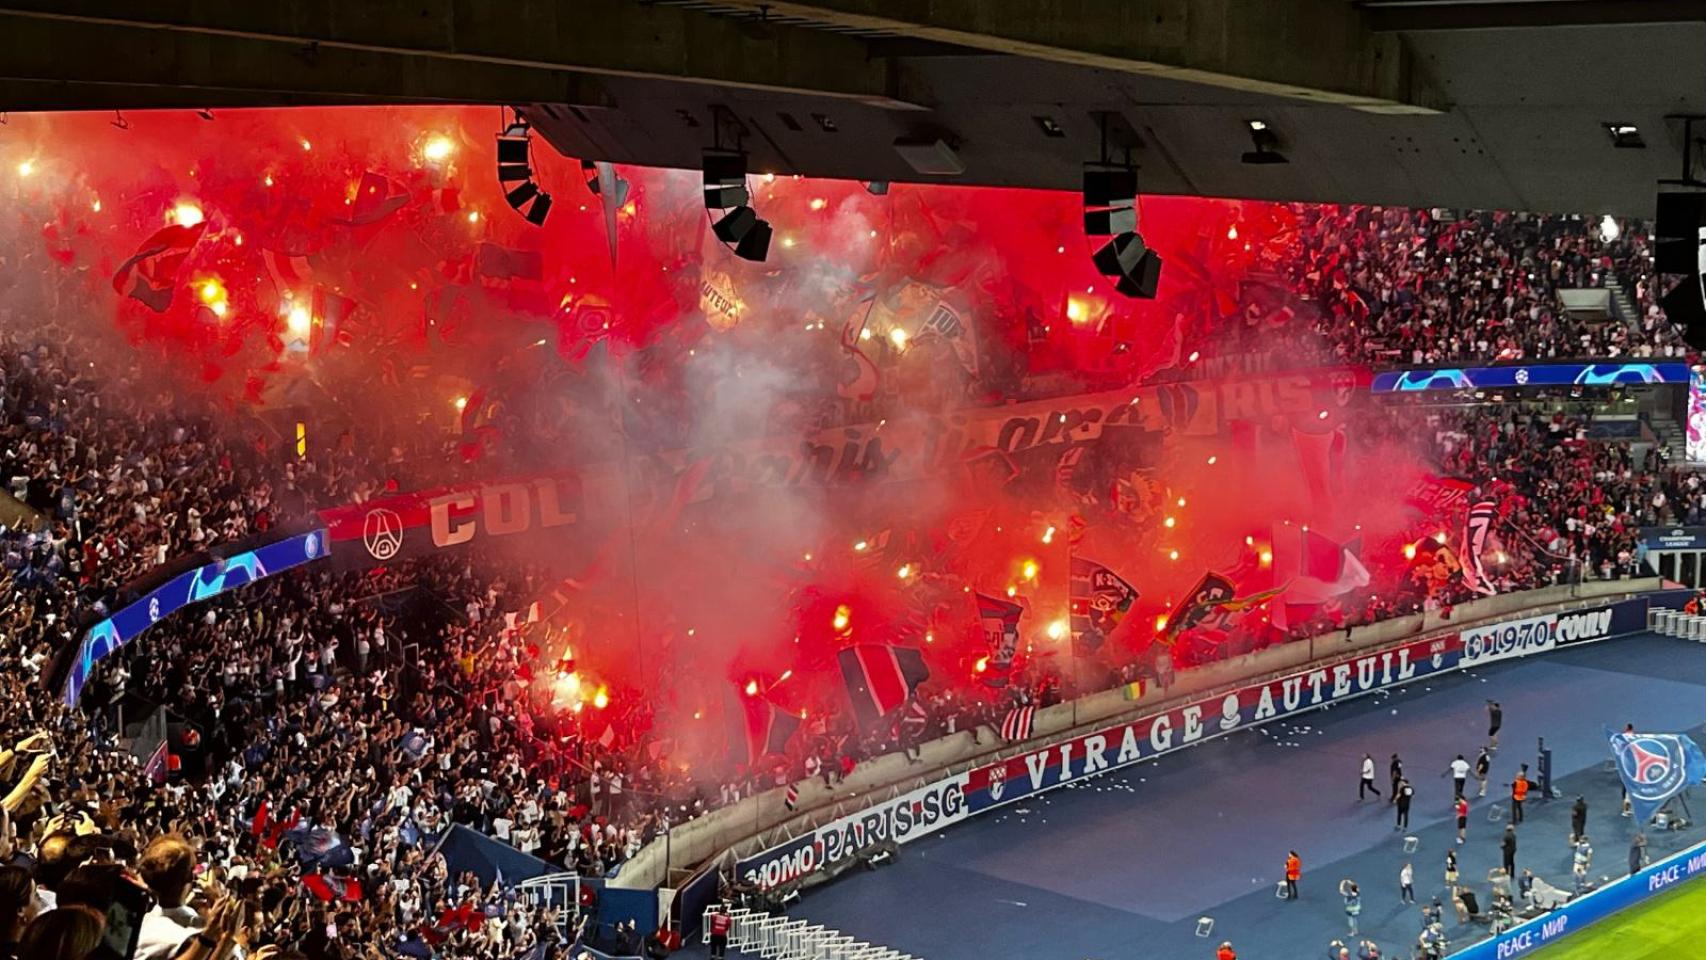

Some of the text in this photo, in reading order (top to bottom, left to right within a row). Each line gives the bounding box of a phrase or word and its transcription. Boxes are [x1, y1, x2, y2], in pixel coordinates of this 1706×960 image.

[1490, 621, 1548, 656] 1970
[1025, 648, 1415, 790] VIRAGE AUTEUIL
[744, 844, 814, 891] MOMO
[1649, 864, 1680, 891] PEACE
[1497, 930, 1532, 960] PEACE
[1542, 914, 1568, 940] МИР
